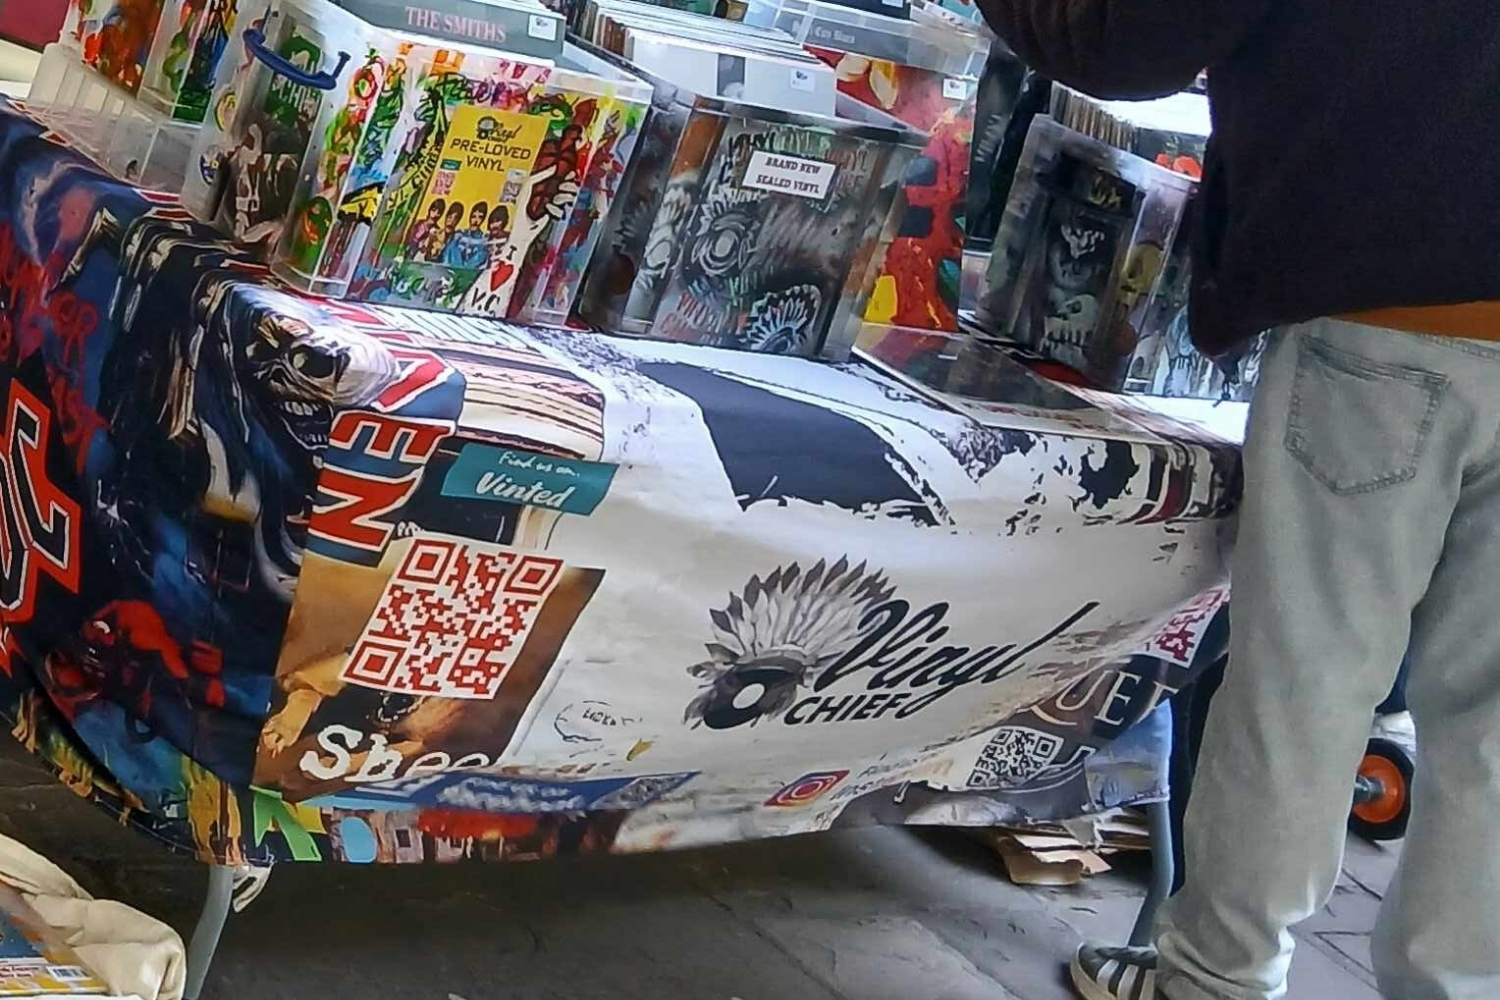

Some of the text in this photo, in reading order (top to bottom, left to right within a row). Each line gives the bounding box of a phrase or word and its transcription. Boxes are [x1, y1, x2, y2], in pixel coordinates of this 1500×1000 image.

[405, 5, 507, 42] THE SMITHS
[450, 137, 532, 160] PRE-LOVED
[466, 154, 505, 172] VINYL
[764, 156, 821, 175] BRAND NEW
[755, 173, 820, 194] SEALED VINYL
[499, 451, 536, 472] Find
[475, 470, 578, 509] Vinted
[813, 598, 1099, 717] Vinyl
[784, 692, 908, 726] CHIEF
